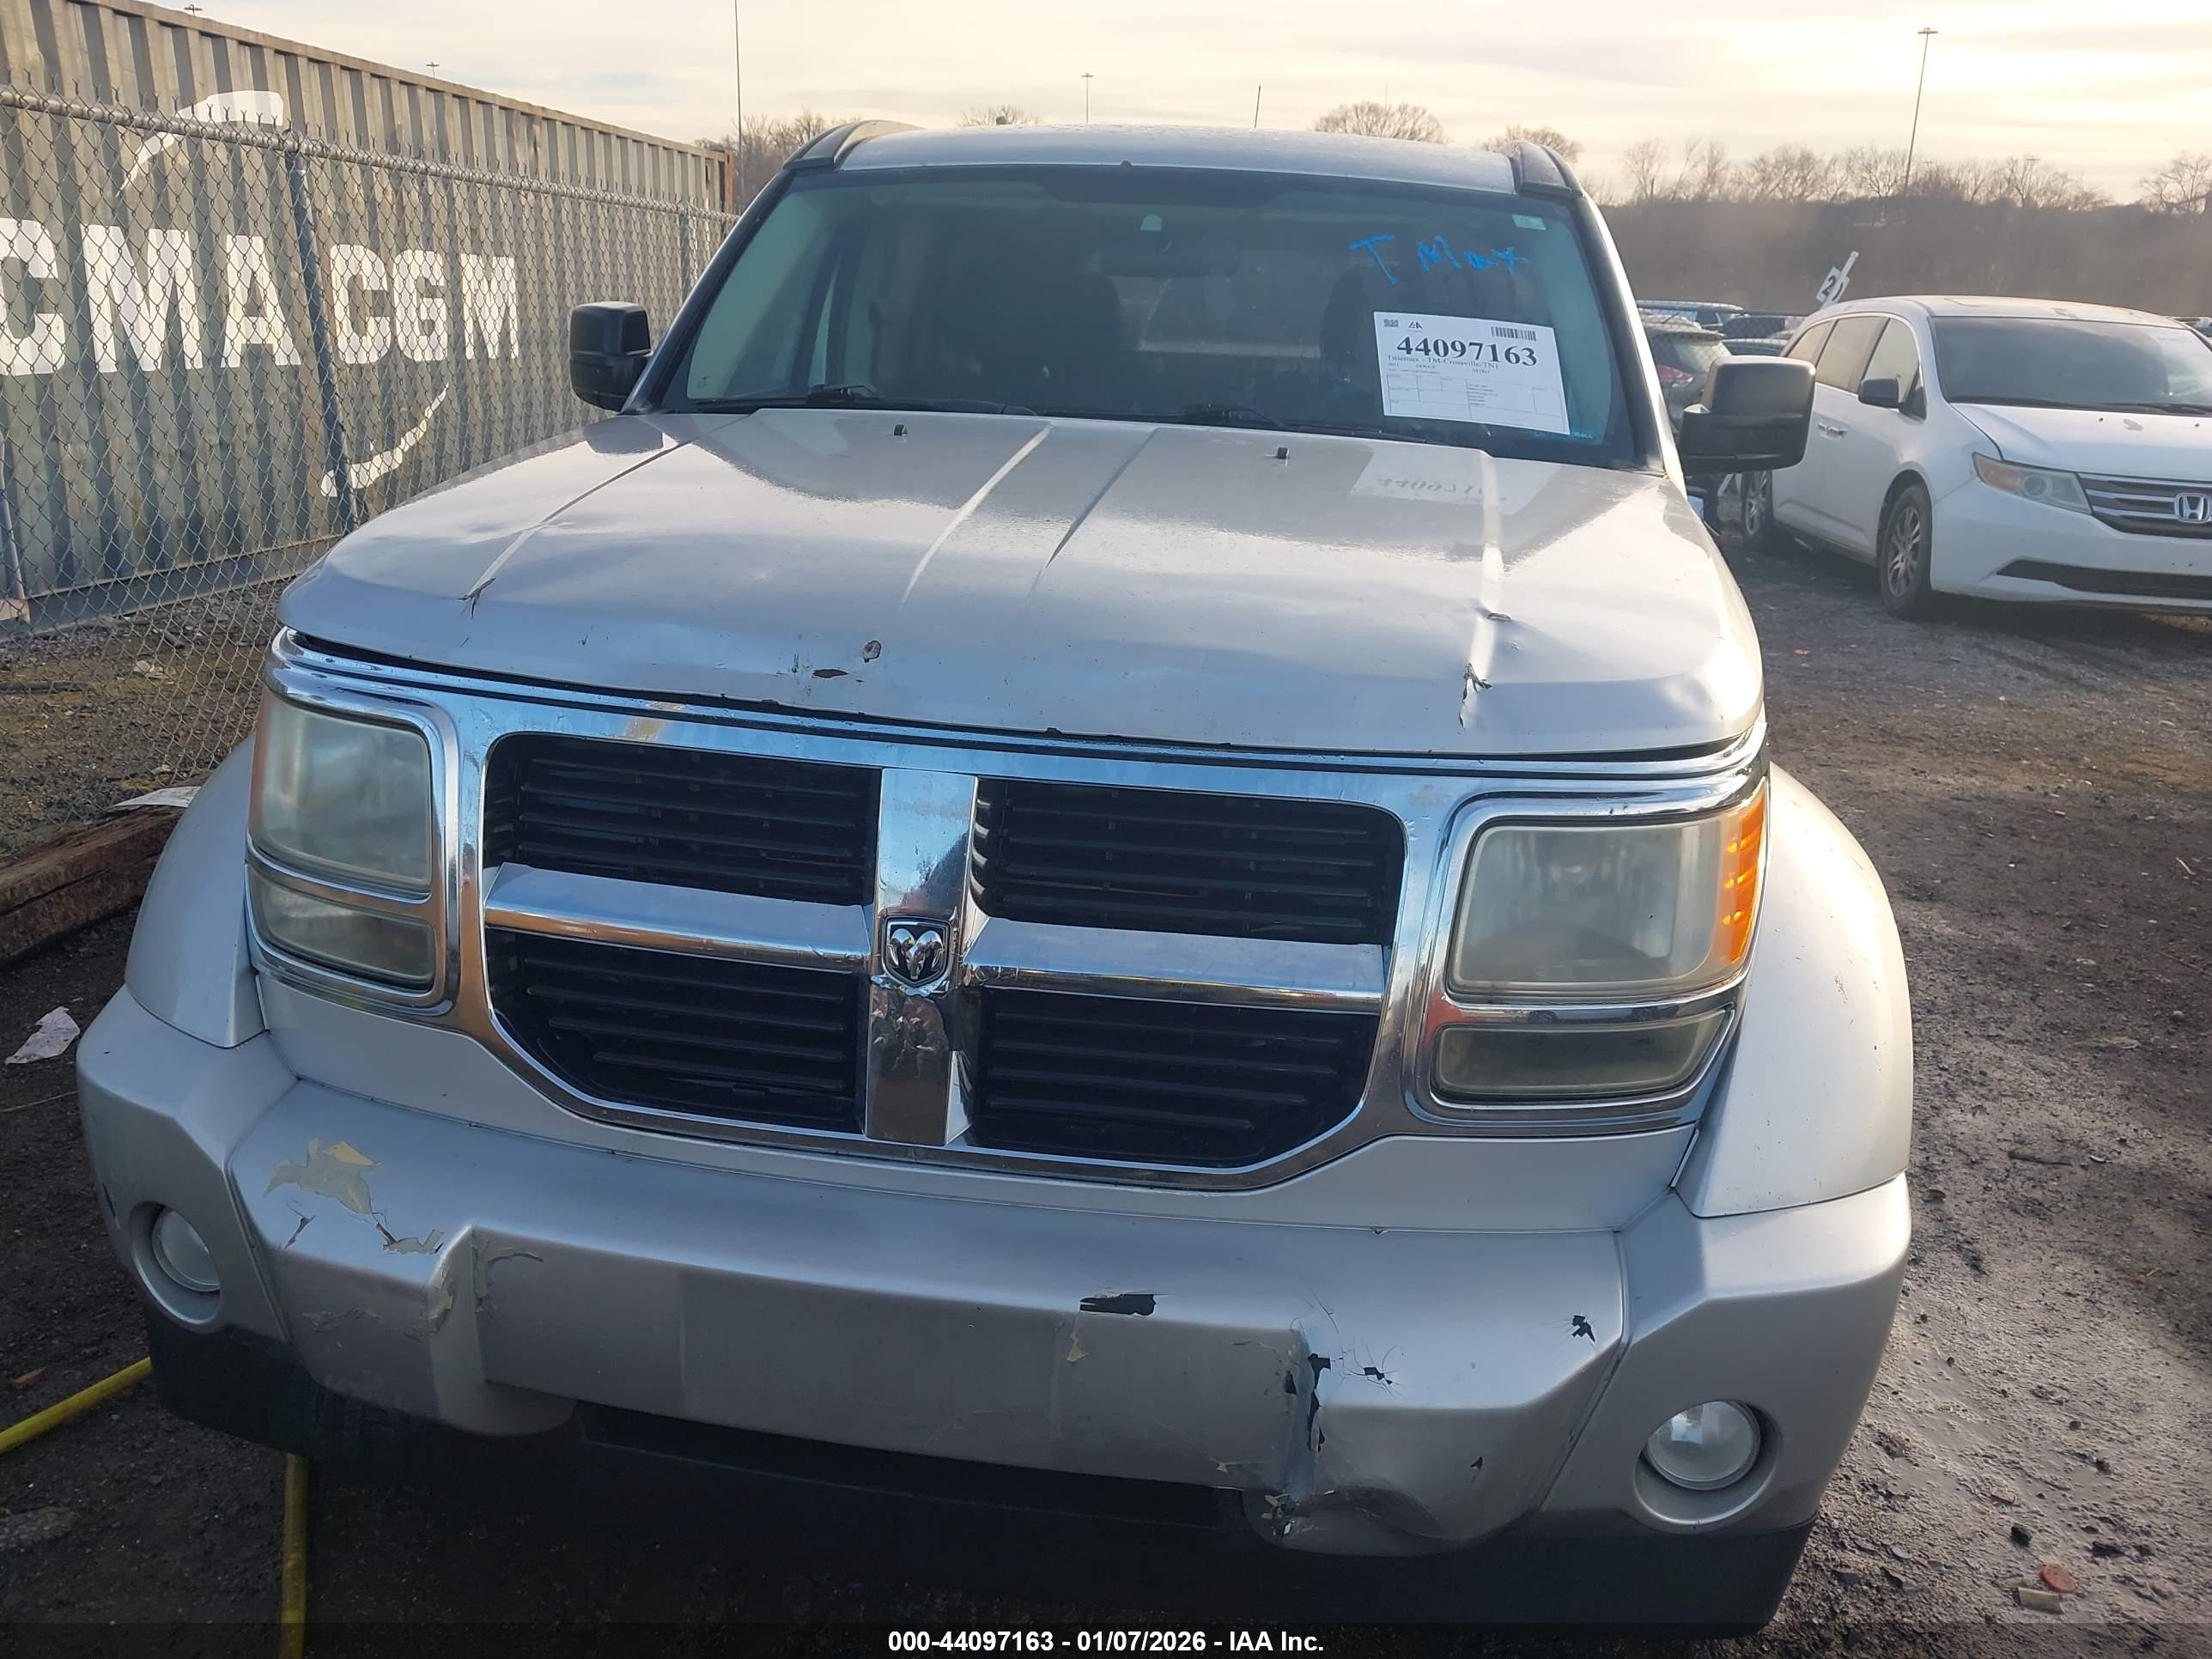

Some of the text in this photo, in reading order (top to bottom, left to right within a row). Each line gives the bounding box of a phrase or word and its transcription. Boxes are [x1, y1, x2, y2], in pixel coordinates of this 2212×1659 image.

[1347, 233, 1398, 286] T
[0, 217, 519, 376] CMA CGM
[1396, 336, 1537, 367] 44097163
